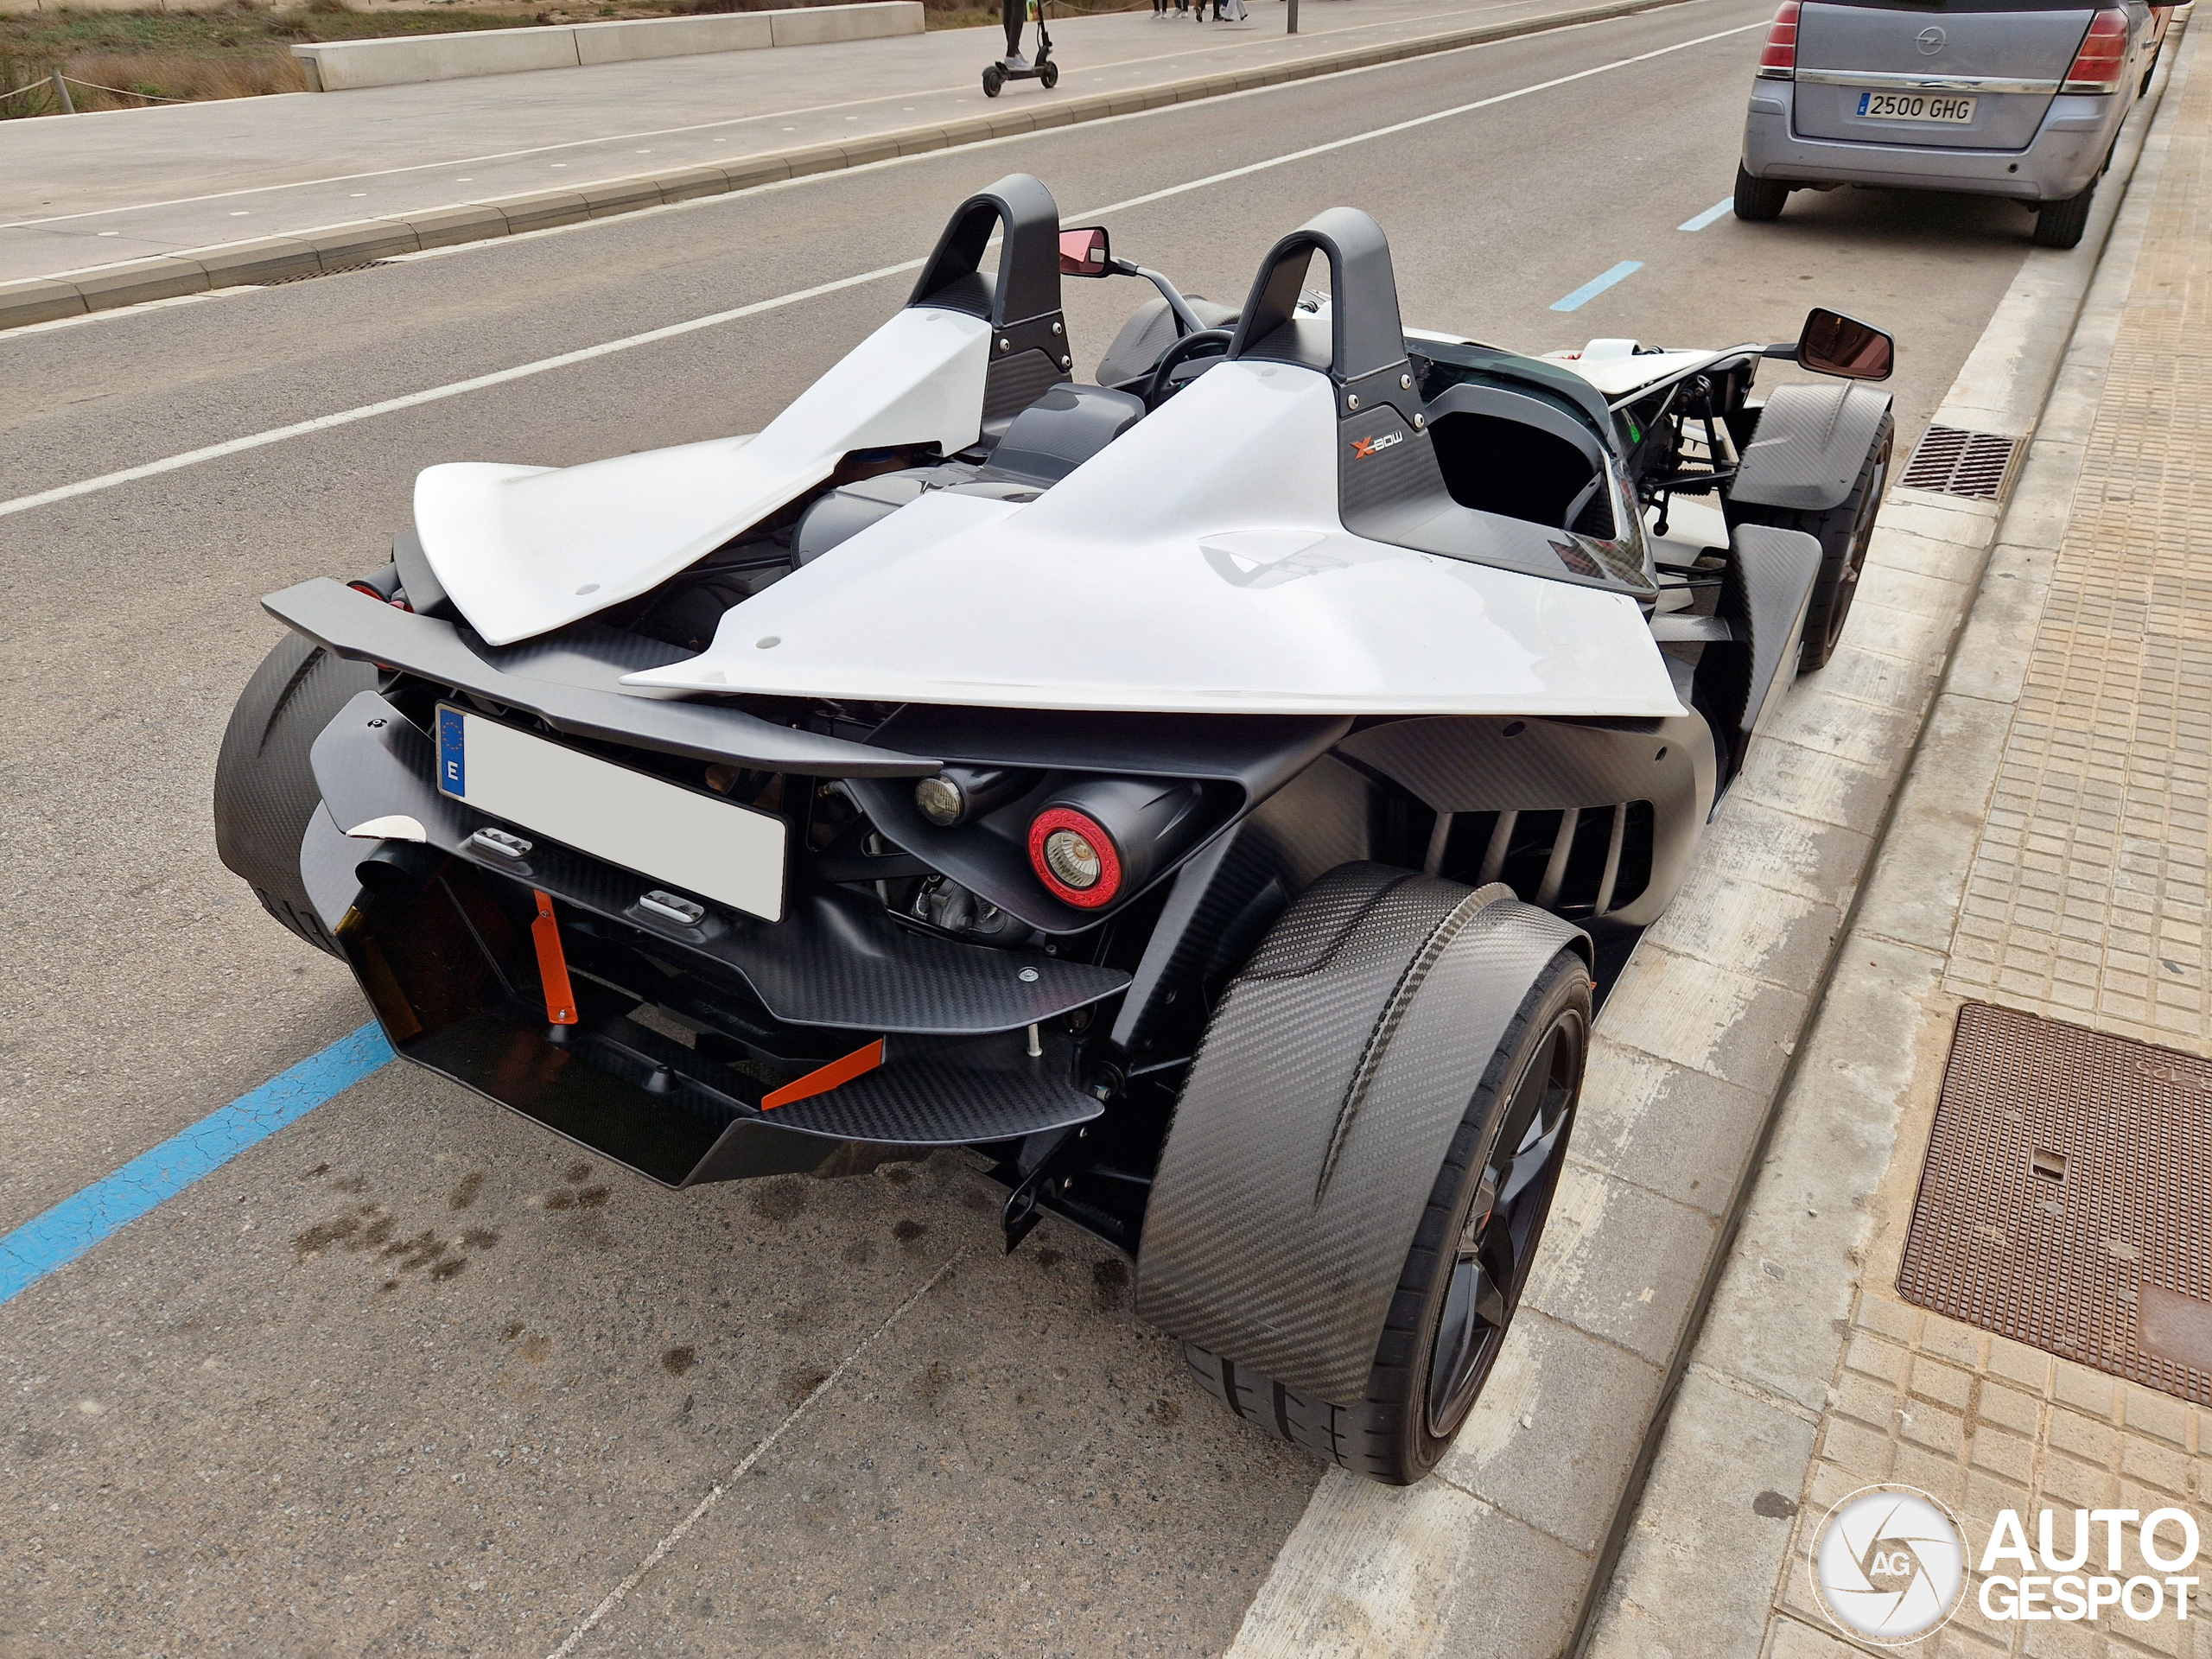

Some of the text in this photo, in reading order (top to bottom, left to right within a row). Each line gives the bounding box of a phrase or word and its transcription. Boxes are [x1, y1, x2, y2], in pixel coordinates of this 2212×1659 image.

[1871, 95, 1969, 119] 2500 GHG
[1350, 430, 1404, 461] X-BOW
[448, 761, 459, 781] E
